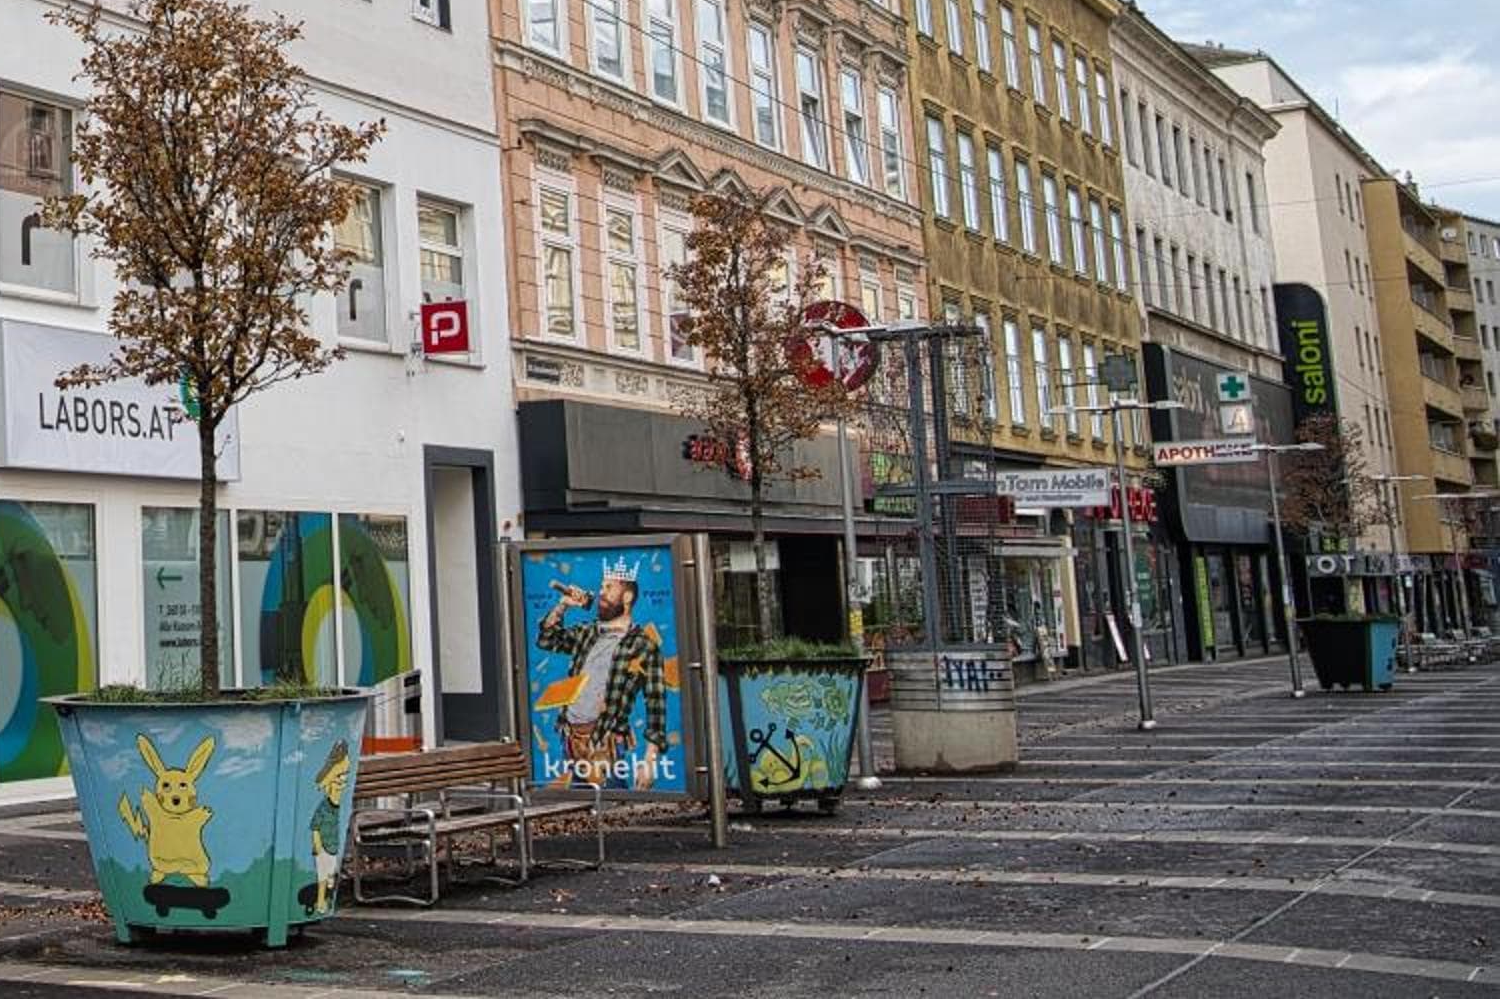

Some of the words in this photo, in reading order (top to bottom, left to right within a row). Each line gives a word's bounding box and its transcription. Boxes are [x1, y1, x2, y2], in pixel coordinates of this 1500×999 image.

[1291, 320, 1327, 404] saloni
[39, 392, 182, 442] LABORS.AT
[545, 752, 676, 779] kronehit
